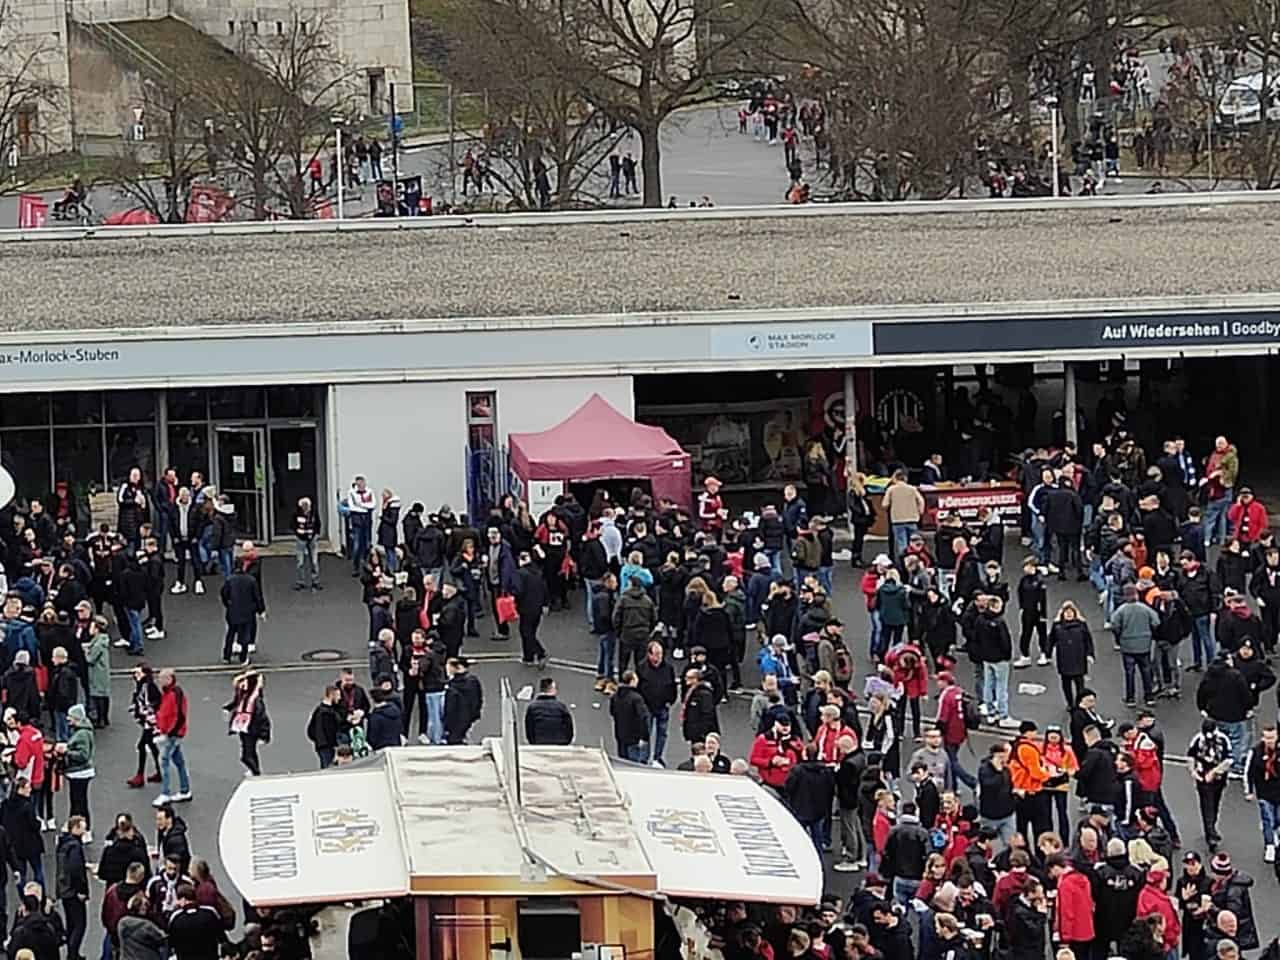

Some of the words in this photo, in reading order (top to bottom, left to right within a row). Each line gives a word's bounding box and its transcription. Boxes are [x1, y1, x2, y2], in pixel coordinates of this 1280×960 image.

[791, 332, 835, 341] MORLOCK
[1102, 325, 1127, 339] Auf
[1129, 323, 1219, 338] Wiedersehen
